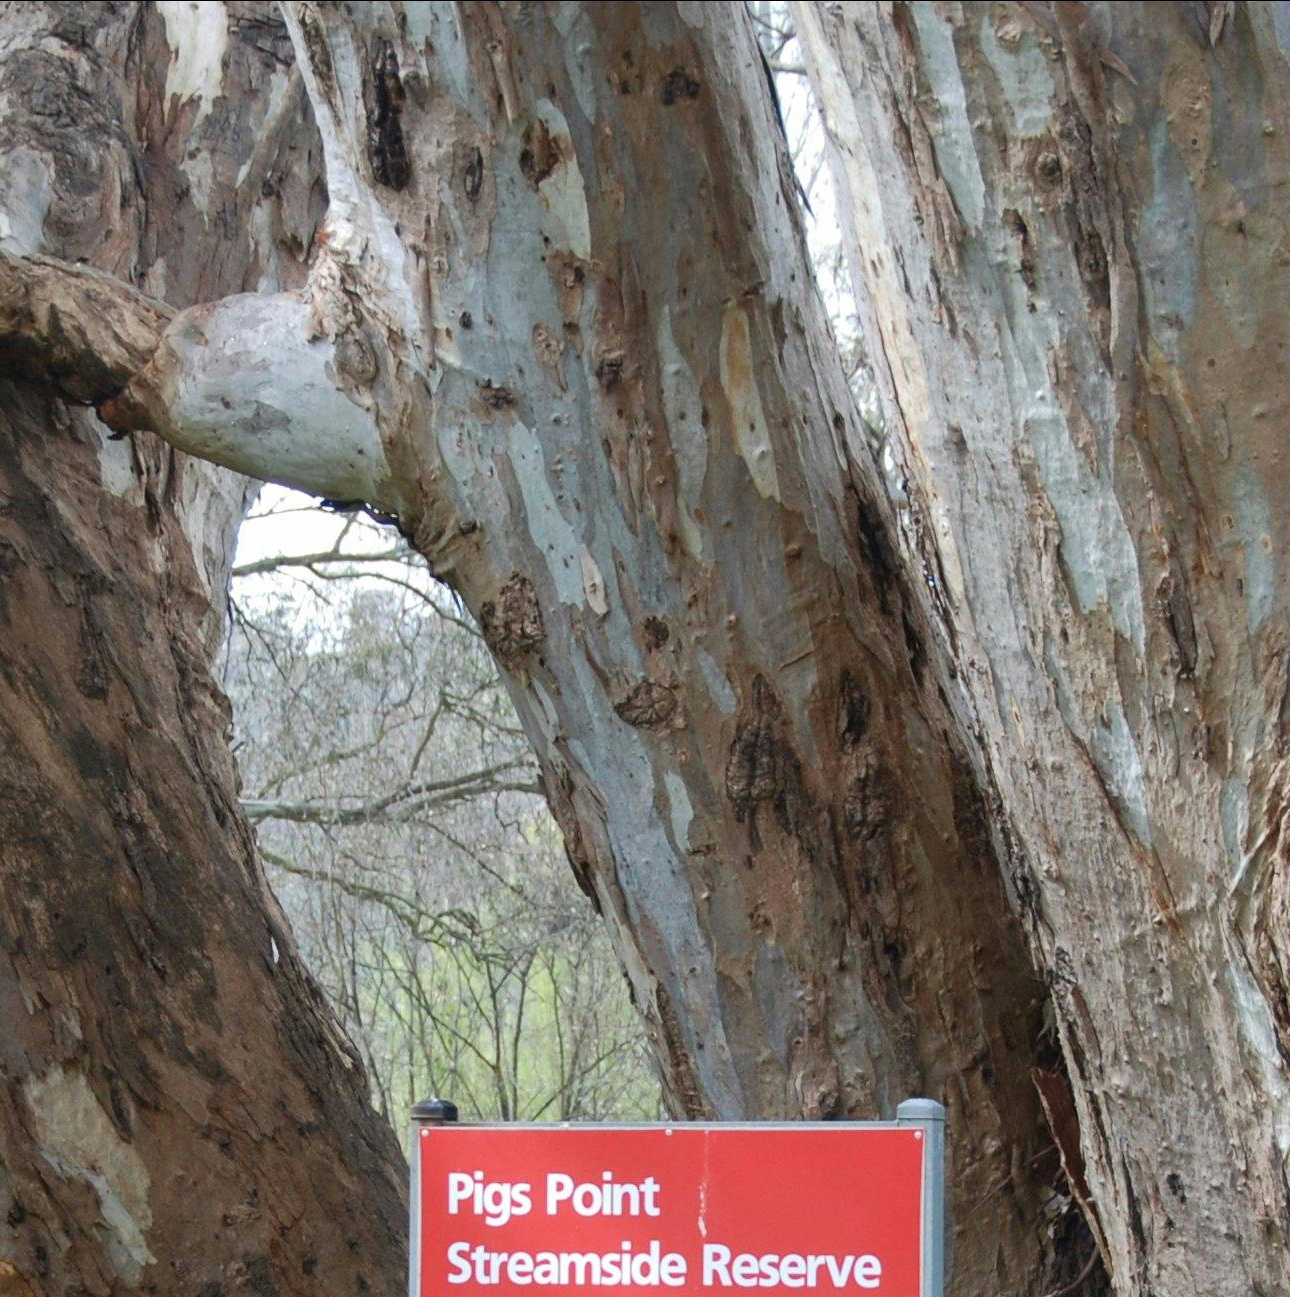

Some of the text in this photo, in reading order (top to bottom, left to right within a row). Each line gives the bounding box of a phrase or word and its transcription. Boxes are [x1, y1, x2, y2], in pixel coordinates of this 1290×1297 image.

[449, 1171, 660, 1226] Pigs Point
[448, 1241, 881, 1288] Streamside Reserve
